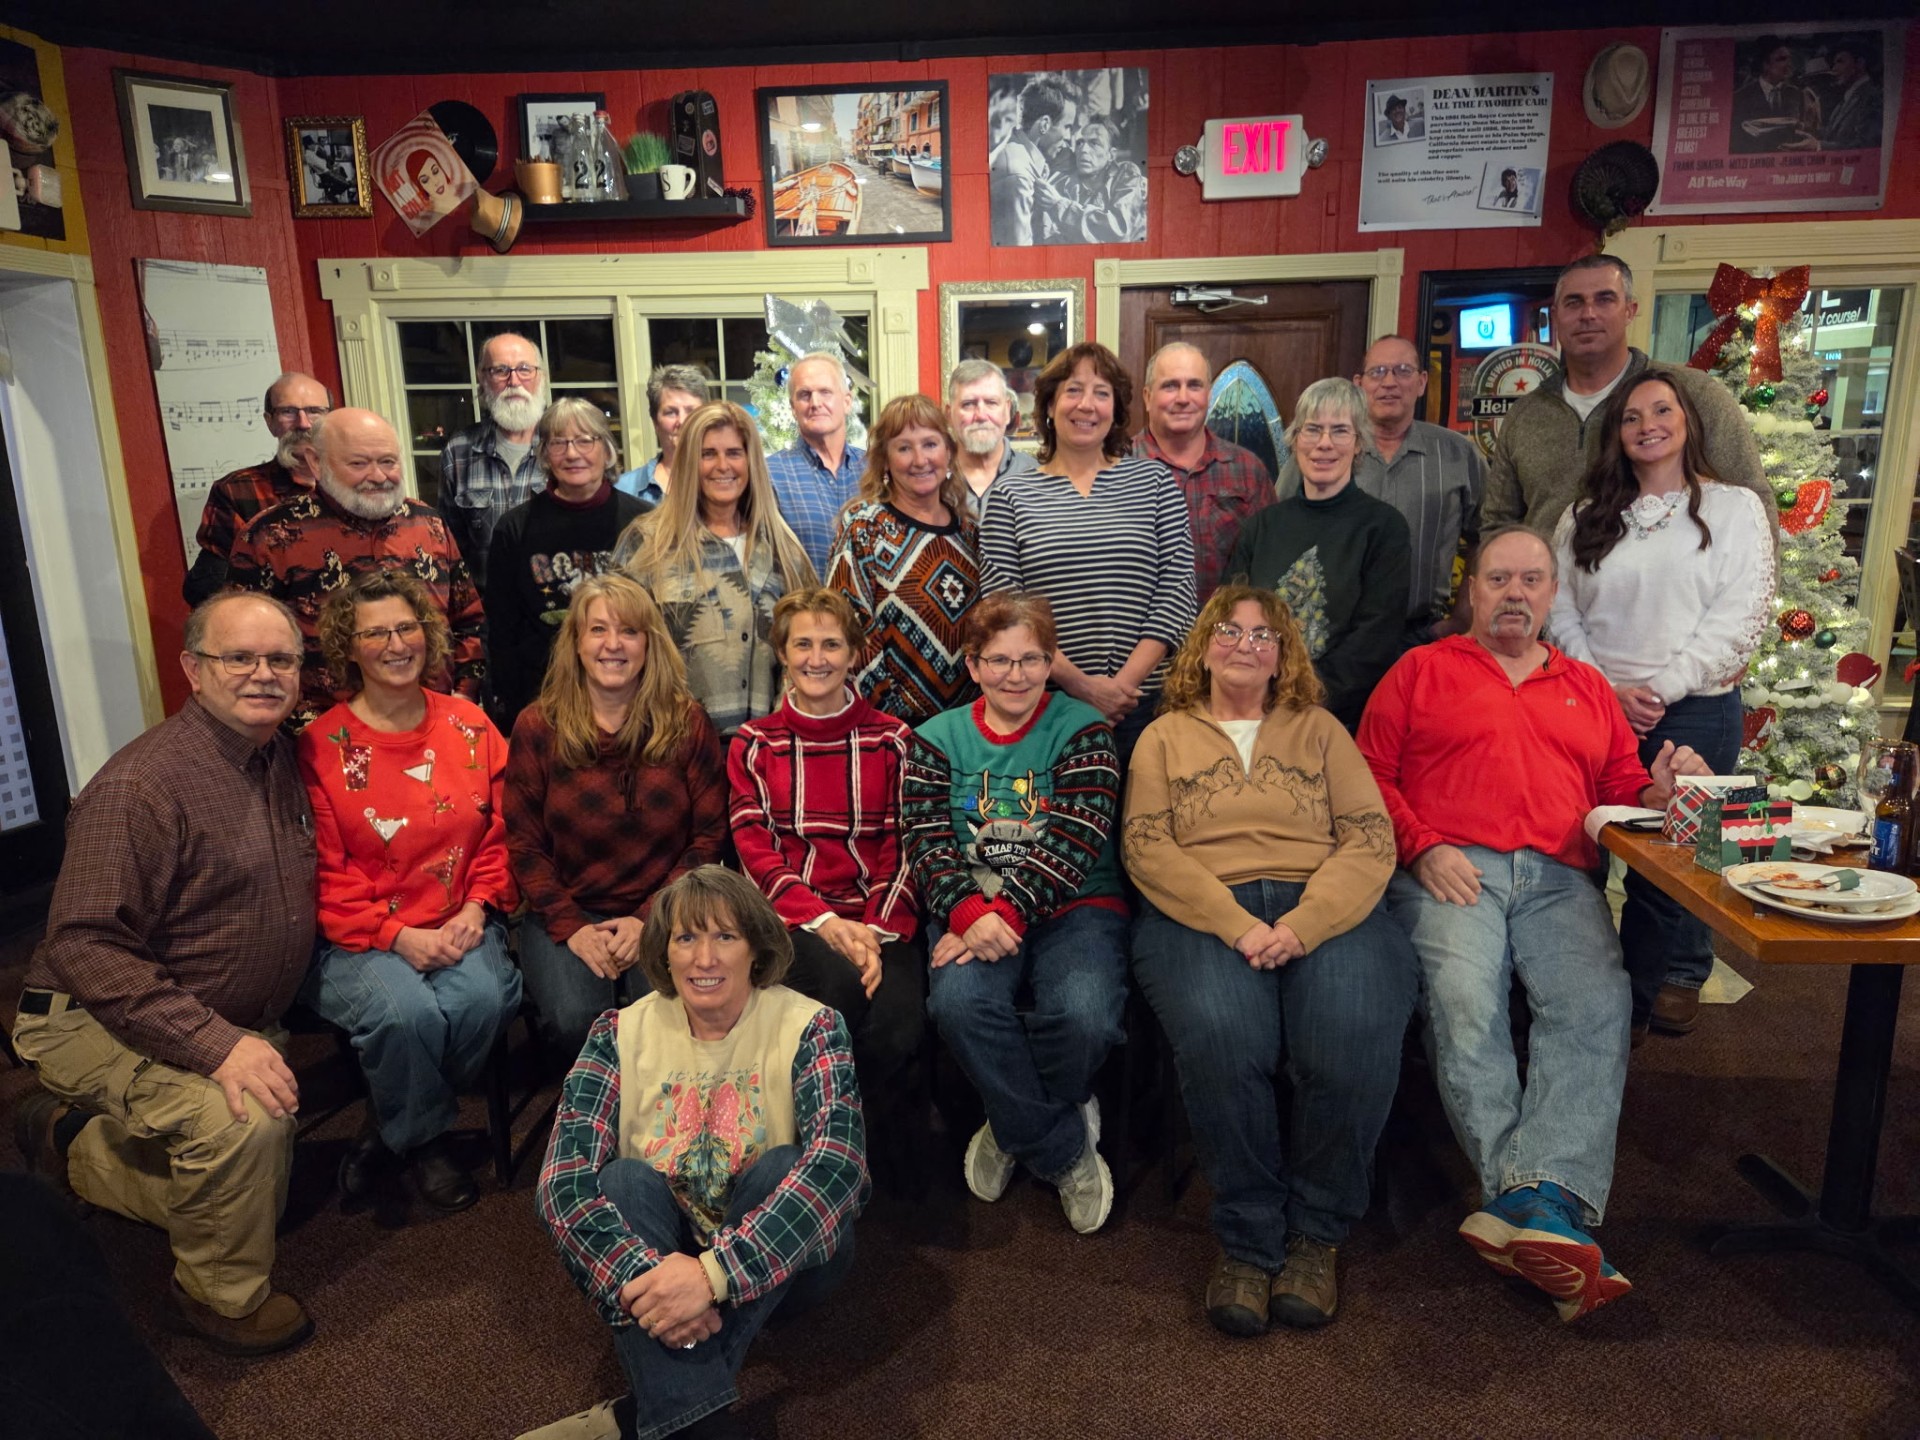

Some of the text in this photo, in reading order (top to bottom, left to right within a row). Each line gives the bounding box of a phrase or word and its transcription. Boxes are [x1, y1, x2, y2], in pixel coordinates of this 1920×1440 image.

[1432, 85, 1540, 99] DEAN MARTIN'S
[1432, 98, 1548, 110] ALL TIME FAVORITE CAR!
[1676, 126, 1708, 139] GREATEST
[1222, 120, 1292, 176] EXIT
[1674, 140, 1698, 154] FILMS!
[1673, 161, 1694, 171] FRANK
[1696, 160, 1724, 170] SINATRA
[574, 160, 590, 189] 2
[595, 159, 606, 189] 2
[1688, 176, 1705, 189] All
[1725, 176, 1748, 189] Way
[1826, 306, 1861, 325] course!
[1825, 352, 1841, 360] INN
[1485, 358, 1513, 388] BREWED
[1515, 356, 1525, 365] IN
[1528, 356, 1554, 378] HOLLA
[984, 843, 1012, 857] XMAS
